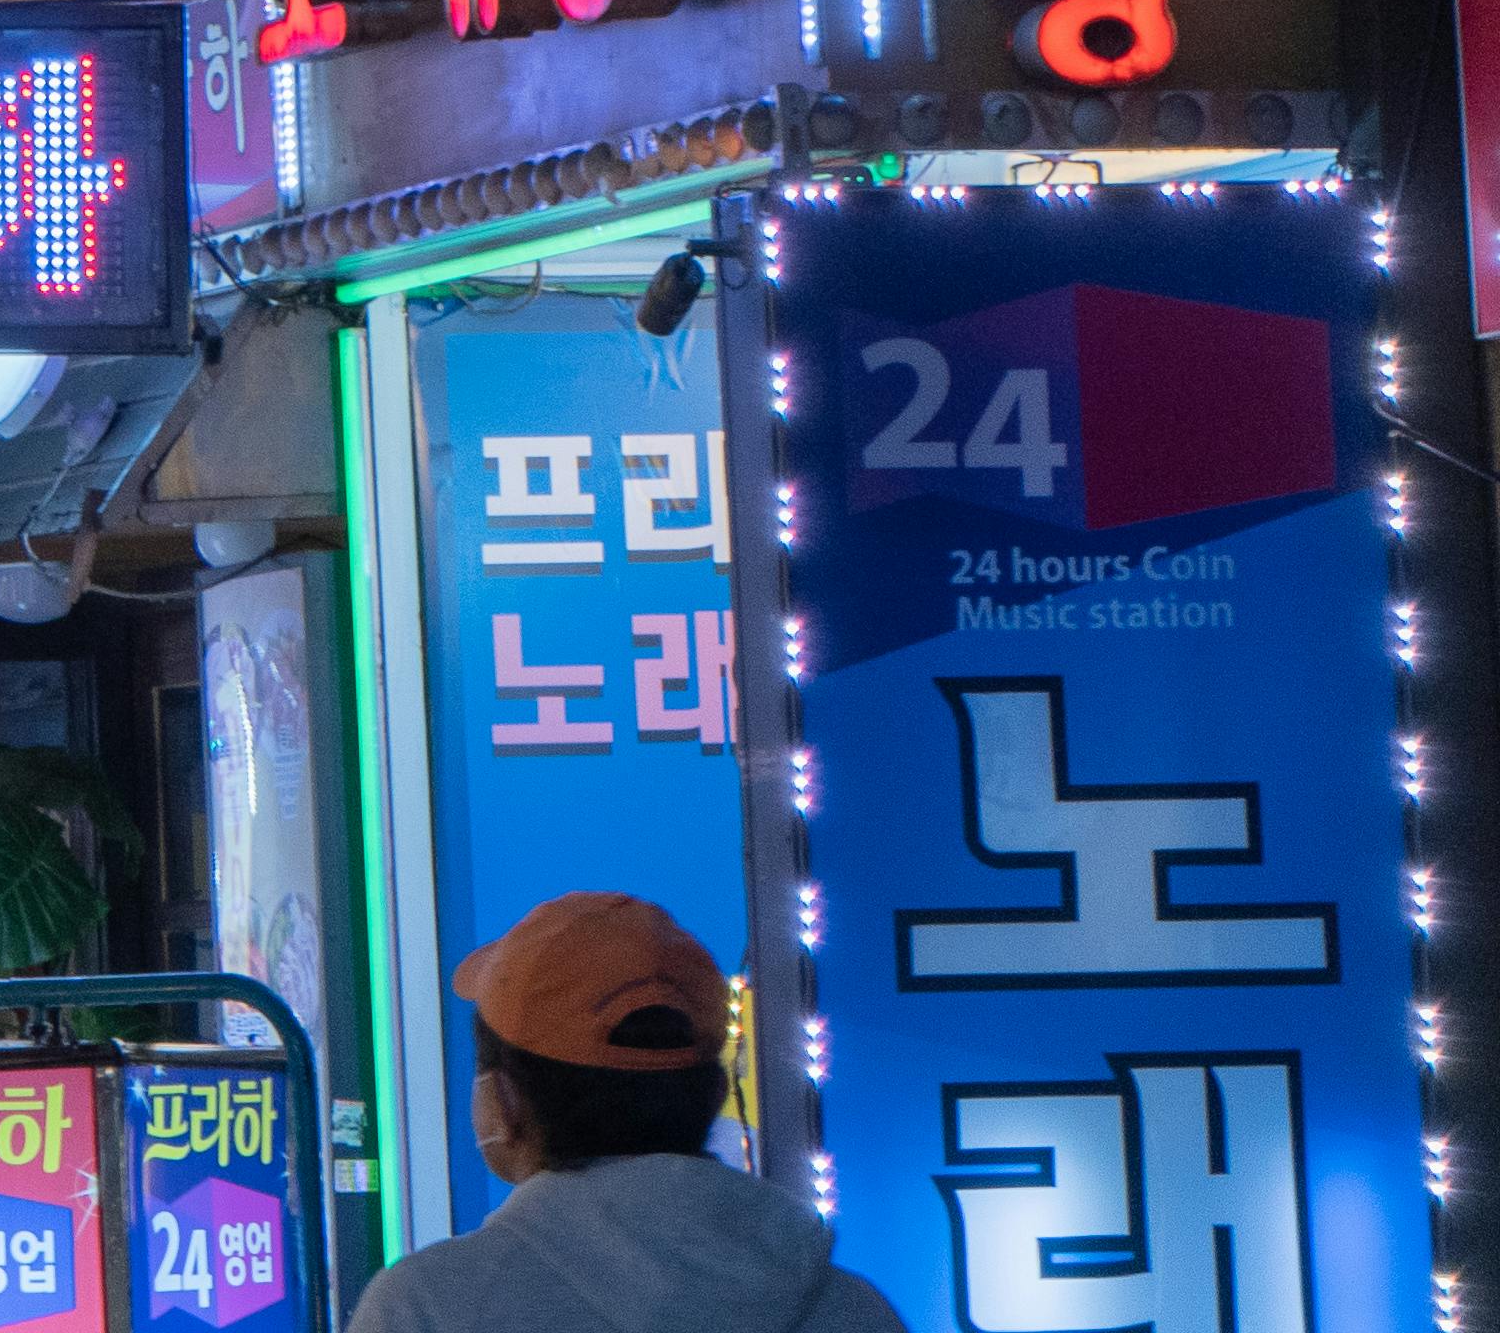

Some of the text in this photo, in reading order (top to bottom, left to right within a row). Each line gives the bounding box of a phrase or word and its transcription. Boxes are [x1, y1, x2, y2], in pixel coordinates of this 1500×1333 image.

[859, 336, 1068, 499] 24
[950, 545, 1236, 584] 24 hours Coin
[957, 593, 1236, 631] Music station
[143, 1076, 280, 1171] 프라하
[149, 1211, 276, 1310] 24 영업
